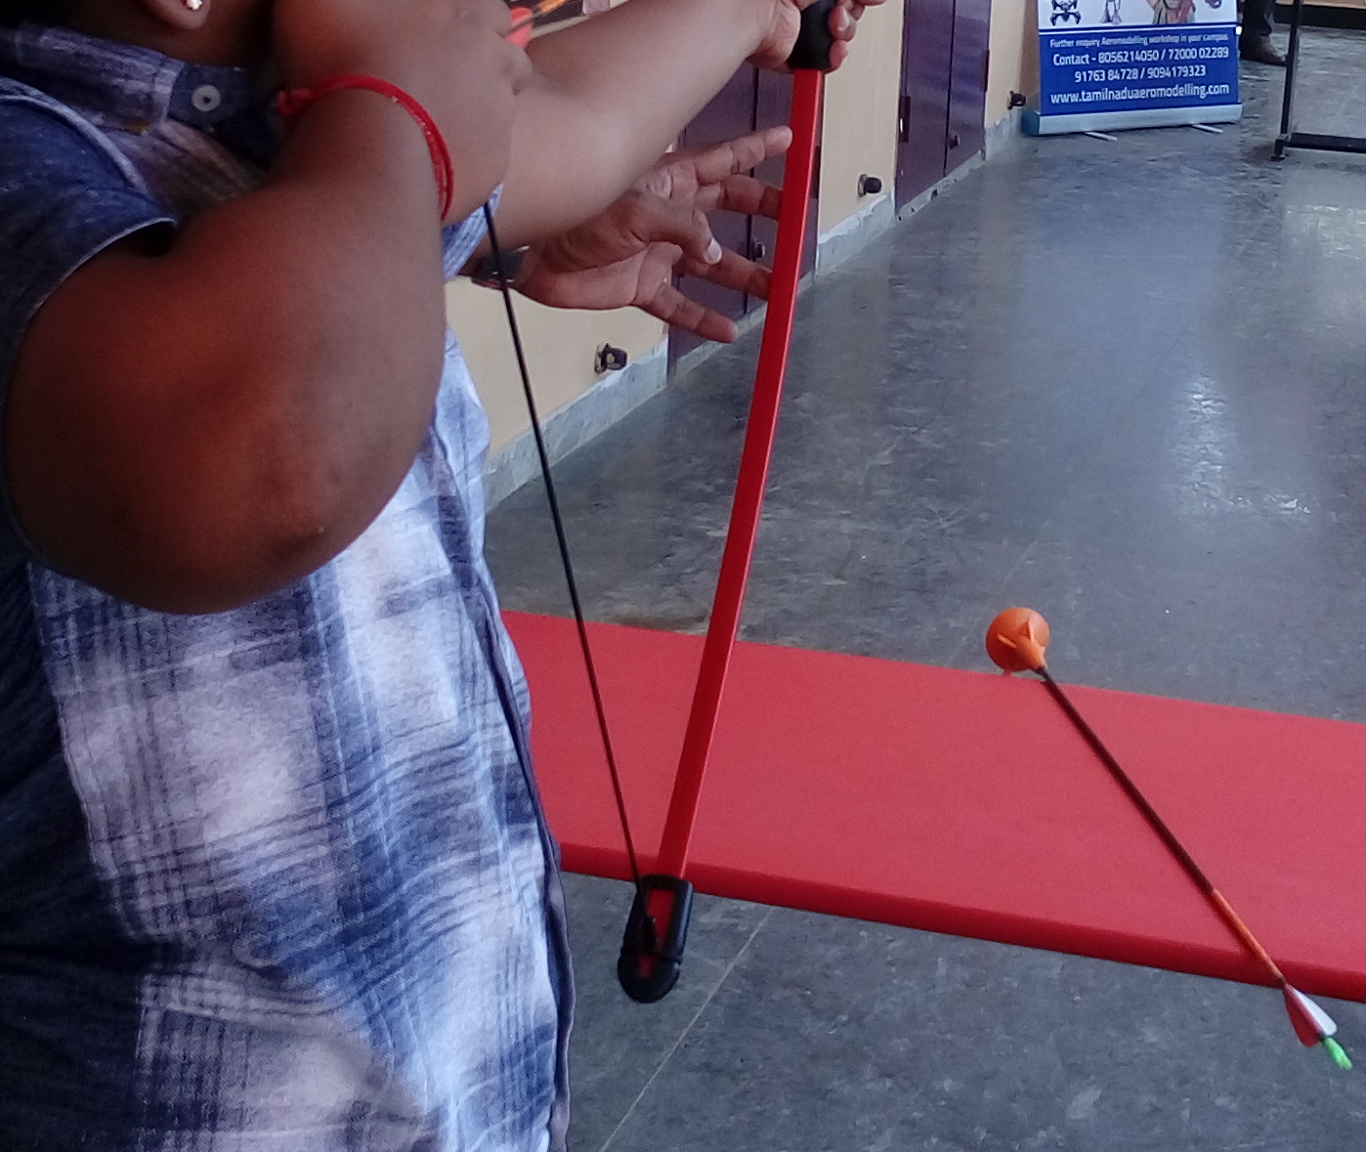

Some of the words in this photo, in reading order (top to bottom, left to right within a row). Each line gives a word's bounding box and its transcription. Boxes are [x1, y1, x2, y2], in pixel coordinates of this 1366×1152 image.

[1053, 53, 1090, 66] Contact
[1098, 50, 1159, 64] 8056214050
[1168, 48, 1197, 61] 72000
[1198, 46, 1229, 60] 02289
[1074, 70, 1106, 83] 91763
[1107, 68, 1138, 81] 84728
[1147, 65, 1206, 79] 9094179323
[1050, 82, 1230, 104] www.tamilnaduaeromodelling.com
